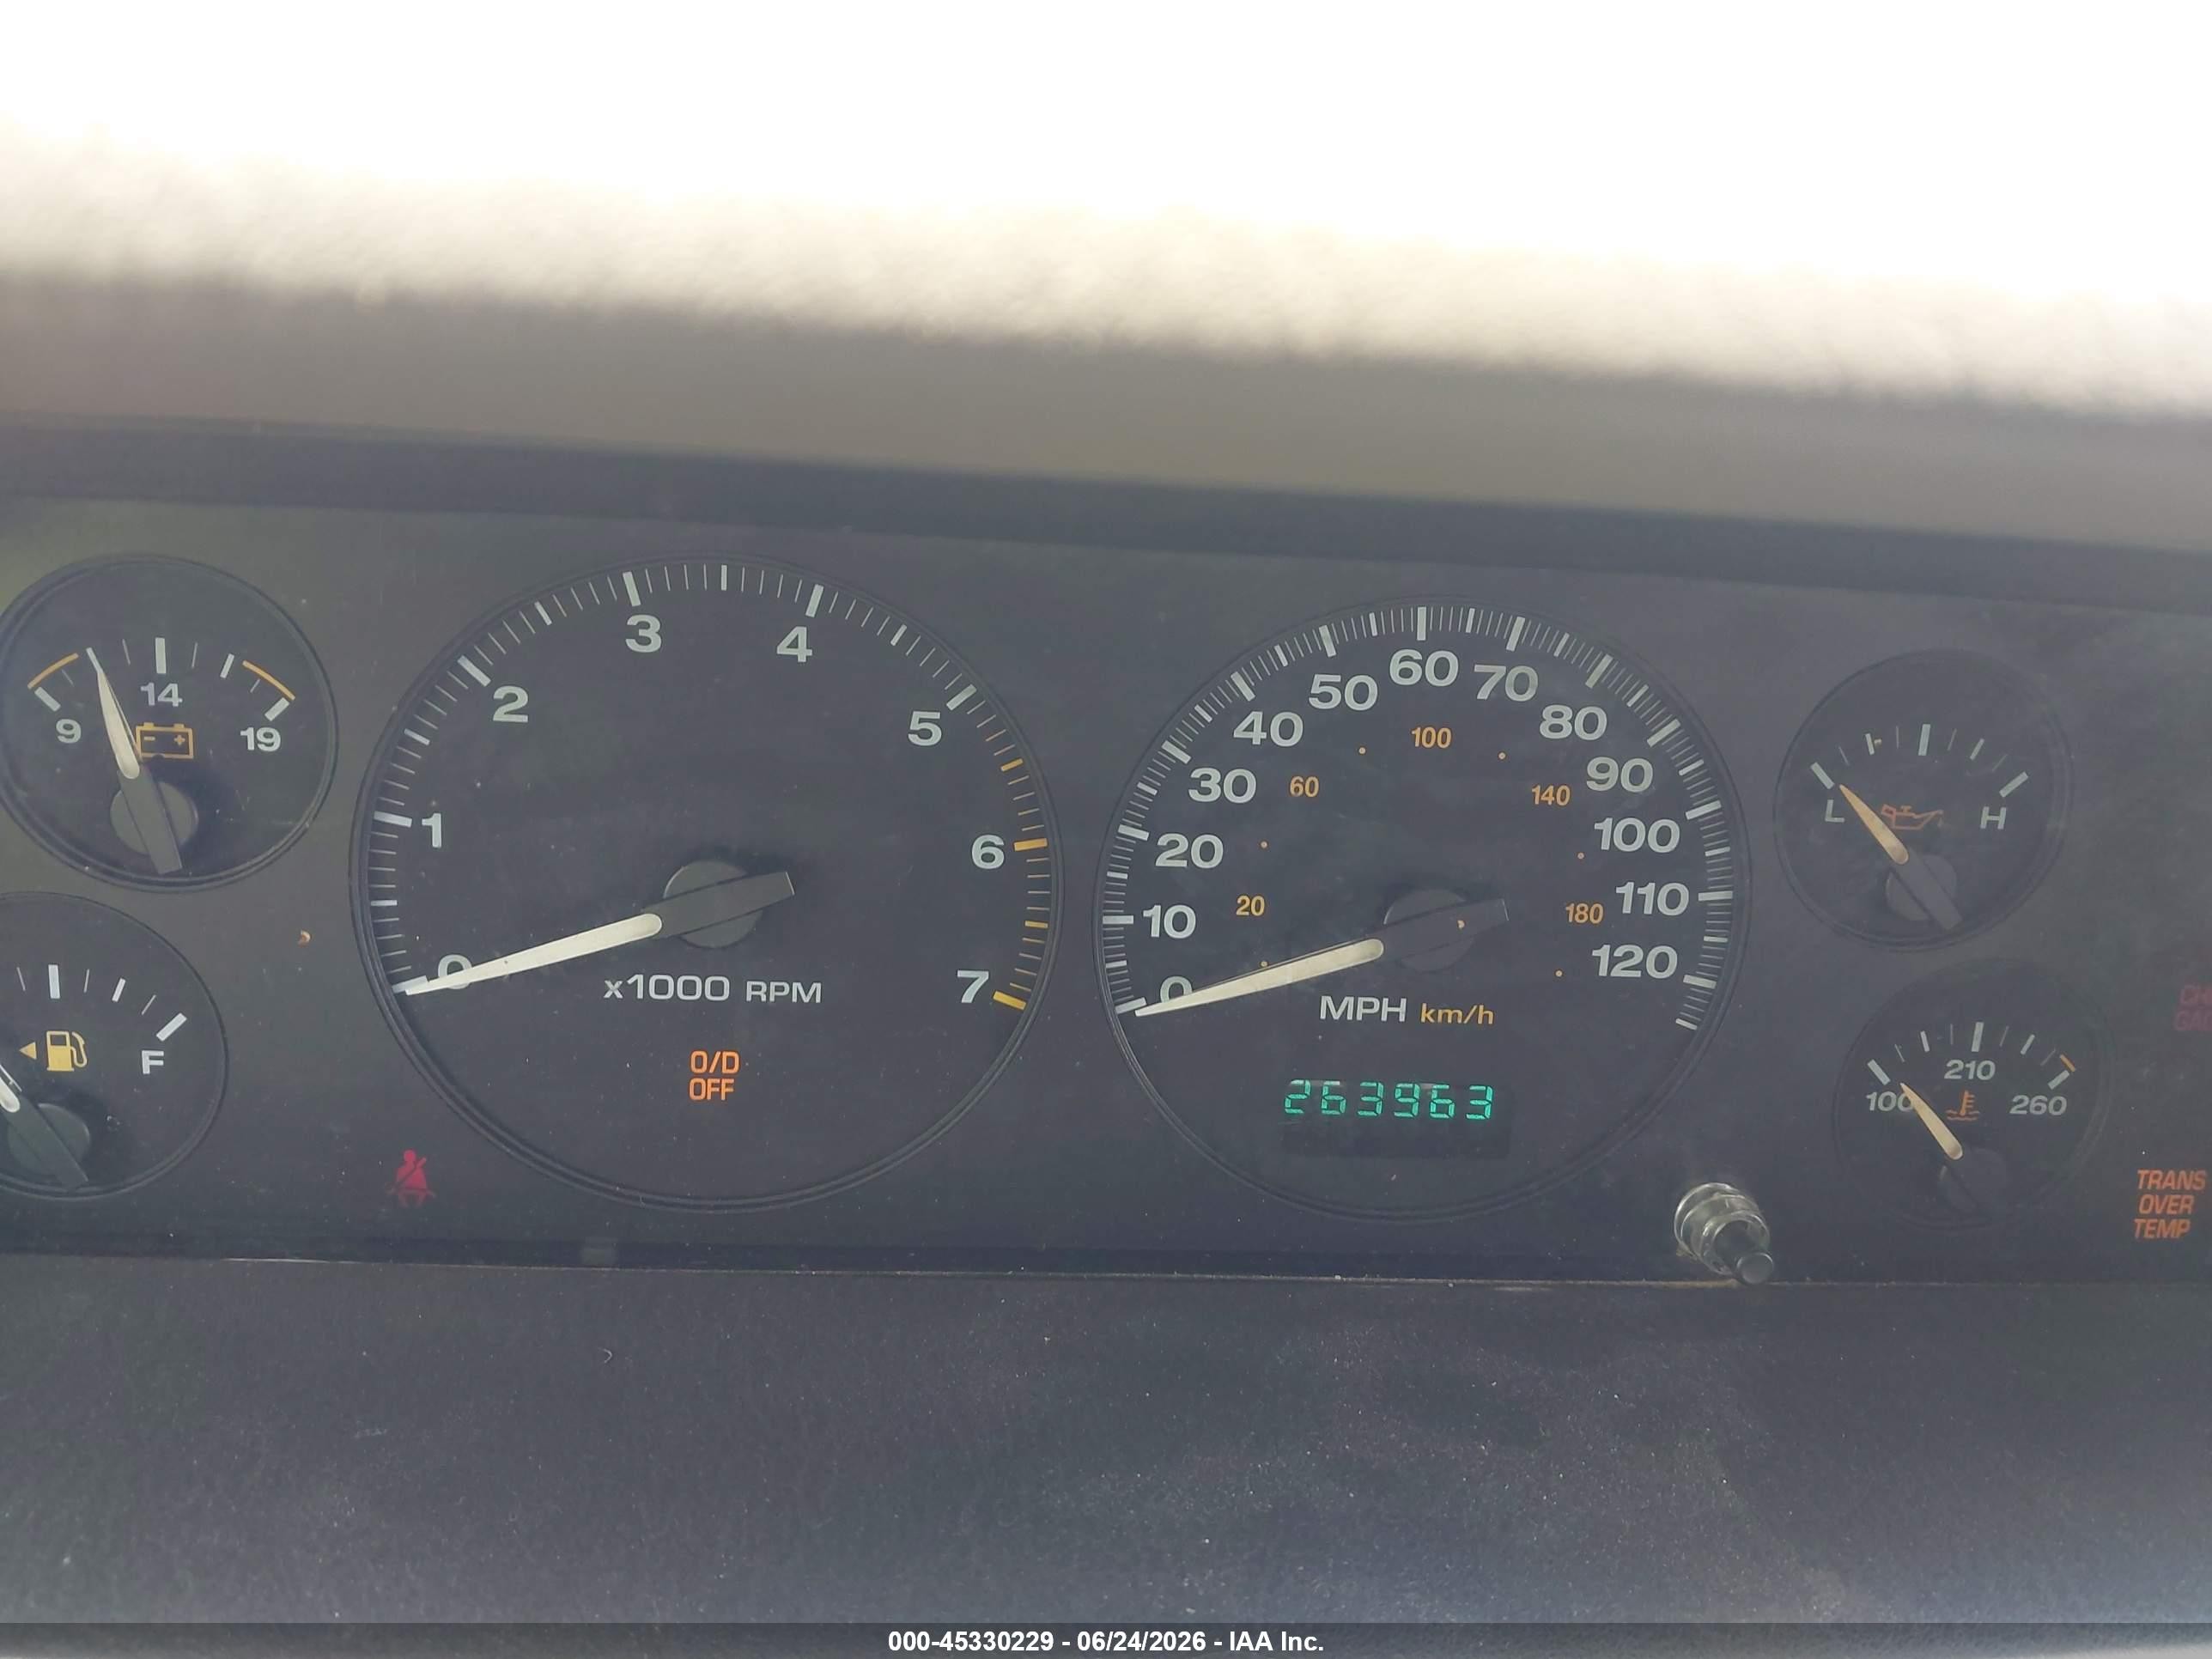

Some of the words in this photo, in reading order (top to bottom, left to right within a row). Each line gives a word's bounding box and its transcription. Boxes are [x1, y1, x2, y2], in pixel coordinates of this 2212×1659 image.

[626, 615, 661, 653] 3
[777, 627, 812, 662] 4
[1390, 649, 1458, 686] 60
[141, 683, 182, 707] 14
[1309, 674, 1377, 710] 50
[1474, 665, 1538, 702] 70
[493, 686, 528, 722] 2
[56, 720, 81, 743] 9
[908, 711, 941, 745] 5
[1234, 712, 1303, 746] 40
[1412, 727, 1451, 748] 100
[1540, 705, 1607, 740] 80
[240, 727, 281, 751] 19
[1188, 768, 1256, 803] 30
[1291, 776, 1318, 797] 60
[1587, 757, 1653, 792] 90
[1532, 786, 1570, 805] 140
[1826, 799, 1845, 823] L
[422, 813, 441, 848] 1
[1980, 806, 2006, 830] H
[1595, 817, 1680, 853] 100
[972, 835, 1004, 869] 6
[1156, 834, 1223, 868] 20
[1237, 896, 1264, 915] 20
[1566, 903, 1603, 923] 180
[1616, 882, 1689, 915] 110
[1144, 905, 1195, 939] 10
[438, 954, 472, 989] 0
[1592, 945, 1677, 978] 120
[604, 975, 729, 1000] x1000
[746, 981, 821, 1003] RPM
[957, 970, 988, 1003] 7
[1160, 976, 1193, 1006] 0
[1321, 996, 1407, 1022] MPH
[1421, 1003, 1493, 1024] km/h
[142, 1050, 164, 1074] F
[691, 1051, 738, 1073] O/D
[1944, 1060, 1995, 1079] 210
[690, 1078, 734, 1100] OFF
[1285, 1080, 1492, 1119] 263963
[2010, 1095, 2067, 1115] 260
[2138, 1170, 2205, 1190] TRANS
[2139, 1194, 2193, 1214] OVER
[2135, 1218, 2190, 1238] TEMP
